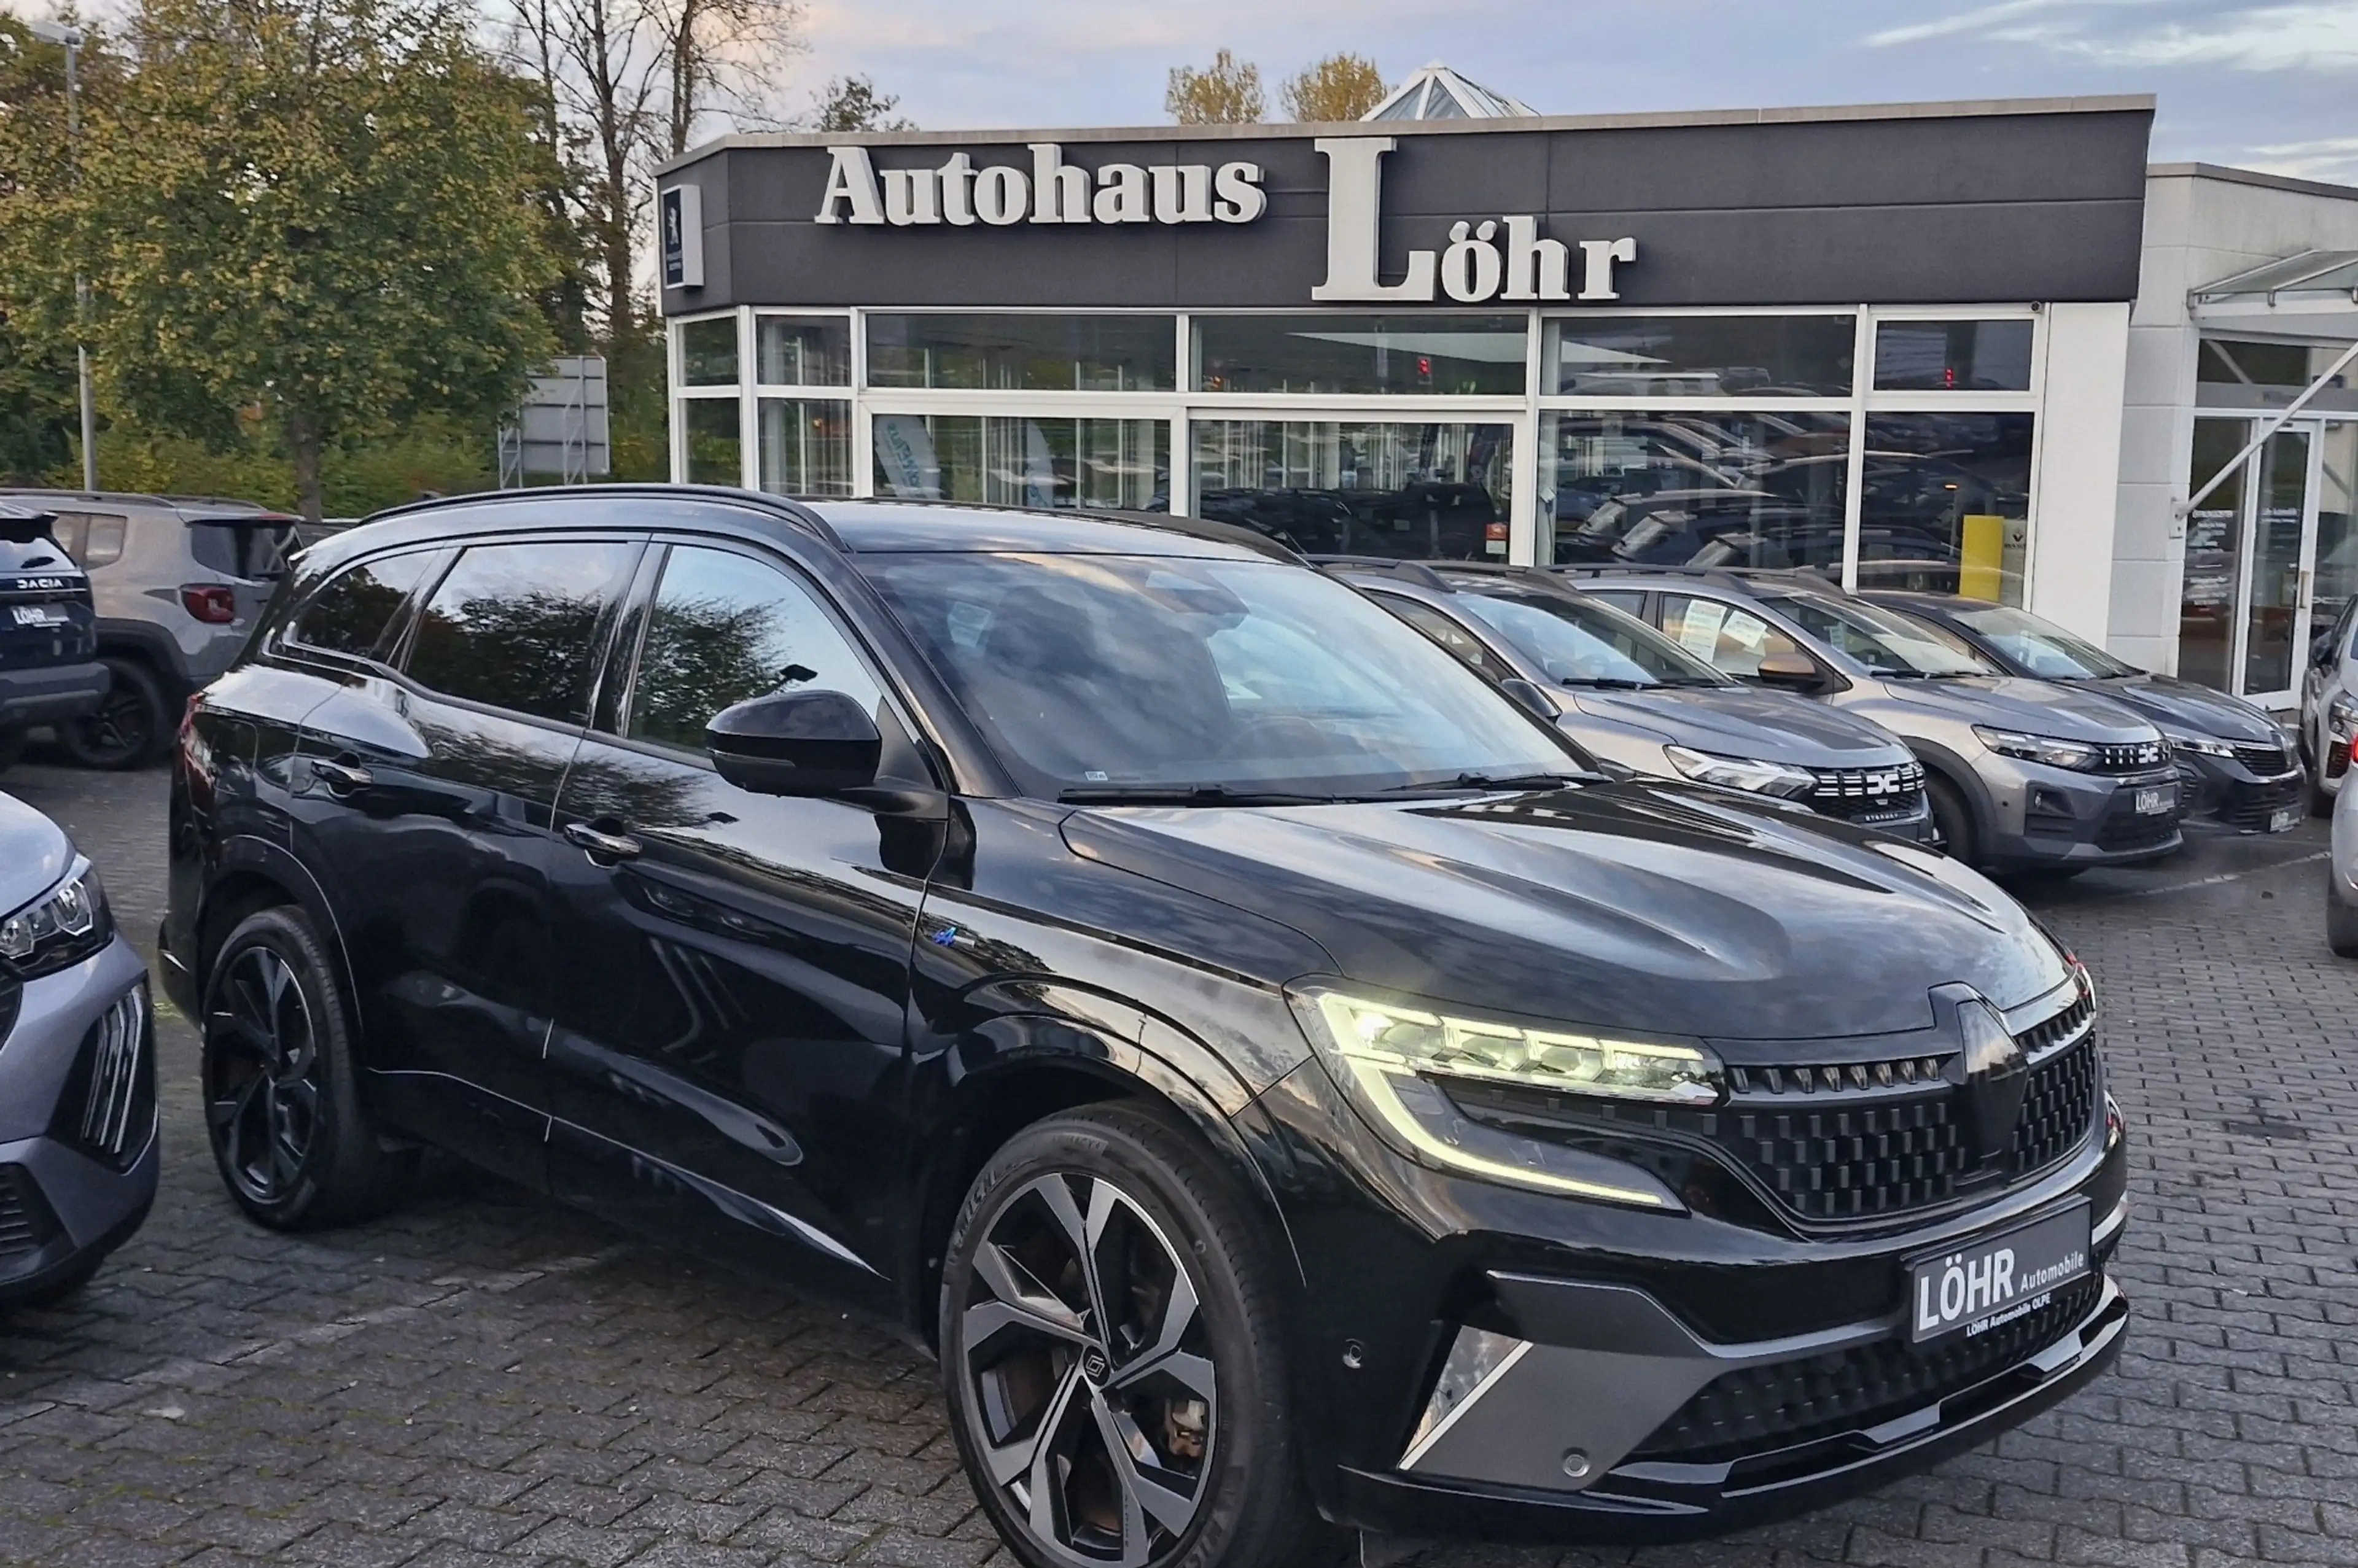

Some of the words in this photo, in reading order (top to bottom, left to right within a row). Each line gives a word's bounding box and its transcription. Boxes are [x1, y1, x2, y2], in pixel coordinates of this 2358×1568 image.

[815, 143, 1267, 226] Autohaus
[1312, 137, 1636, 302] Löhr
[16, 578, 63, 589] DACIA
[2136, 791, 2159, 811] LÖHR
[1919, 1248, 2015, 1331] LÖHR
[2020, 1251, 2084, 1292] Automobile
[1966, 1318, 1989, 1337] LÖHR
[1990, 1302, 2031, 1328] Automobile
[2032, 1292, 2051, 1310] OLPE
